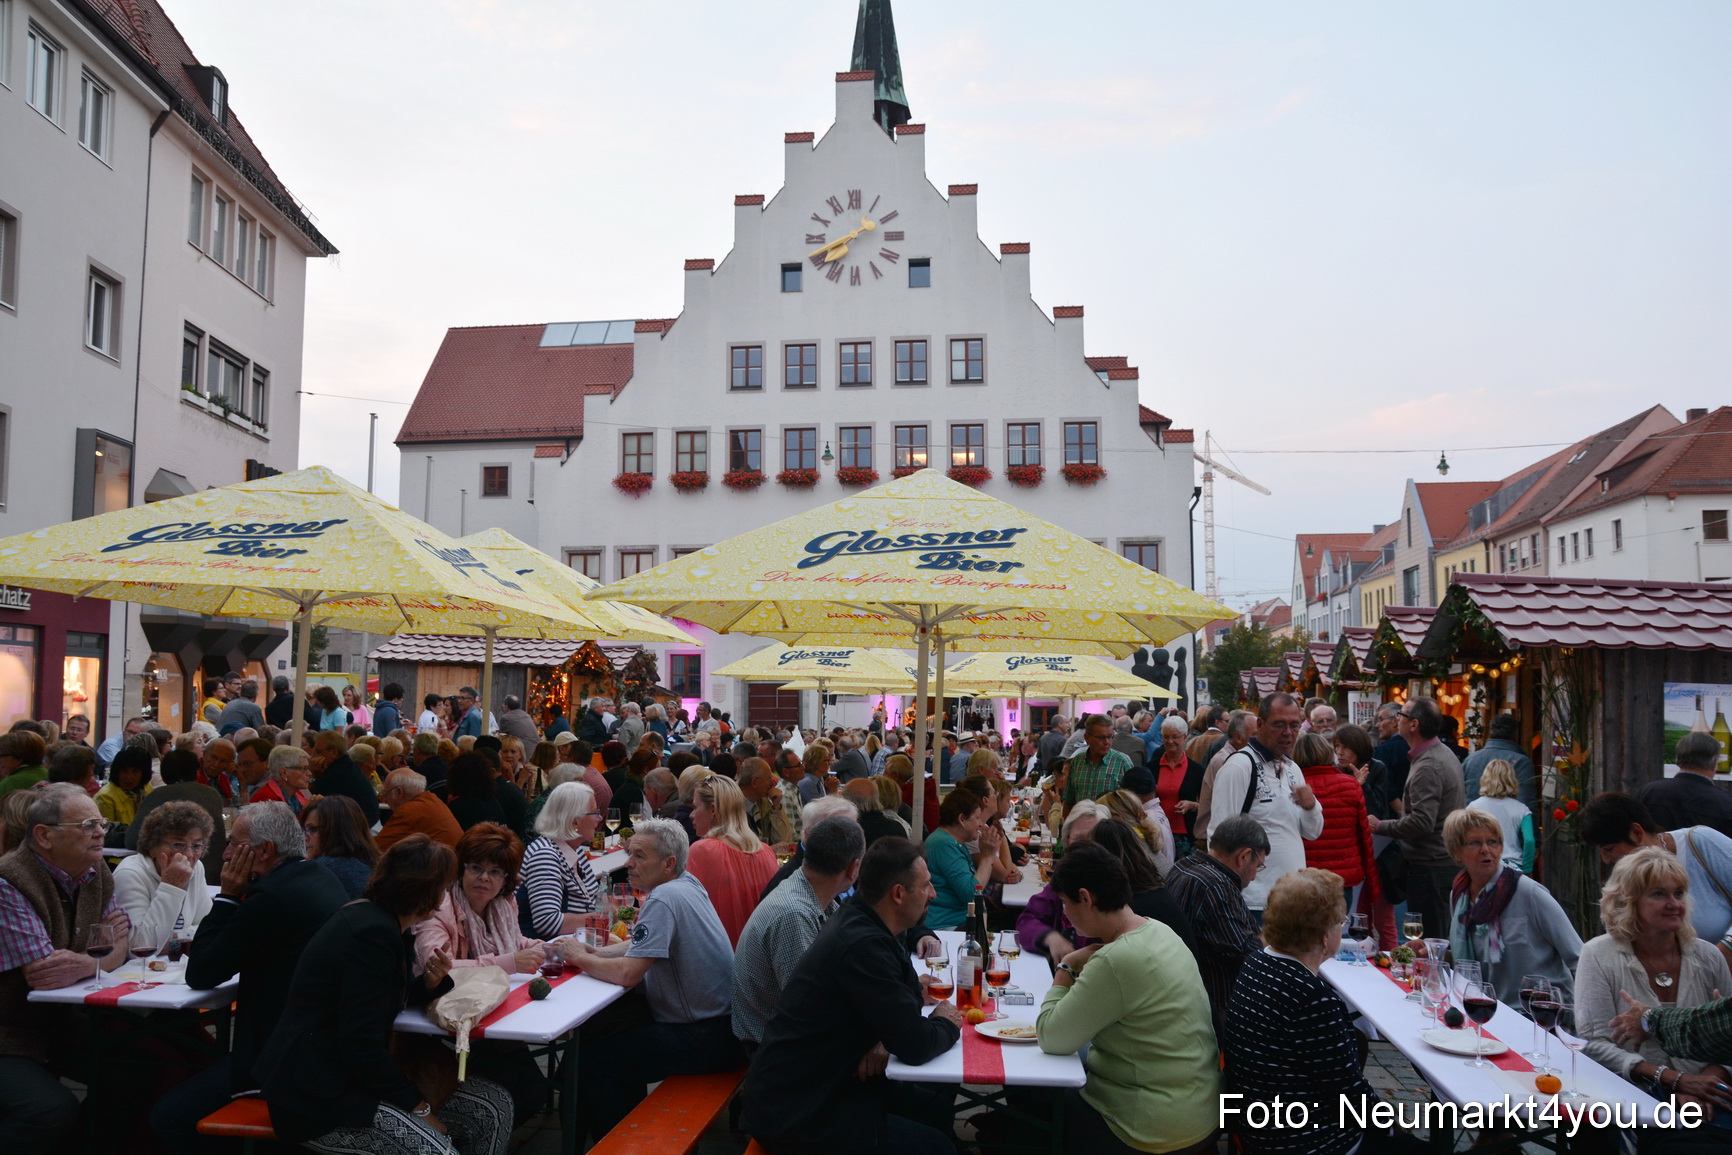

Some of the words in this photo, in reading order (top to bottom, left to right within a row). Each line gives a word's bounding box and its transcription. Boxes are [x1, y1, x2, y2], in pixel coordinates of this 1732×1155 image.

[100, 518, 349, 553] Glossner
[203, 540, 309, 559] Bier
[796, 527, 1029, 570] Glossner
[915, 551, 1025, 574] Bier
[756, 570, 807, 582] Der
[813, 571, 919, 587] hochfeine
[930, 573, 1067, 590] Biergenuss
[777, 650, 855, 666] Glossner
[816, 658, 851, 668] Bier
[1005, 655, 1073, 671] Glossner
[1045, 663, 1078, 673] Bier
